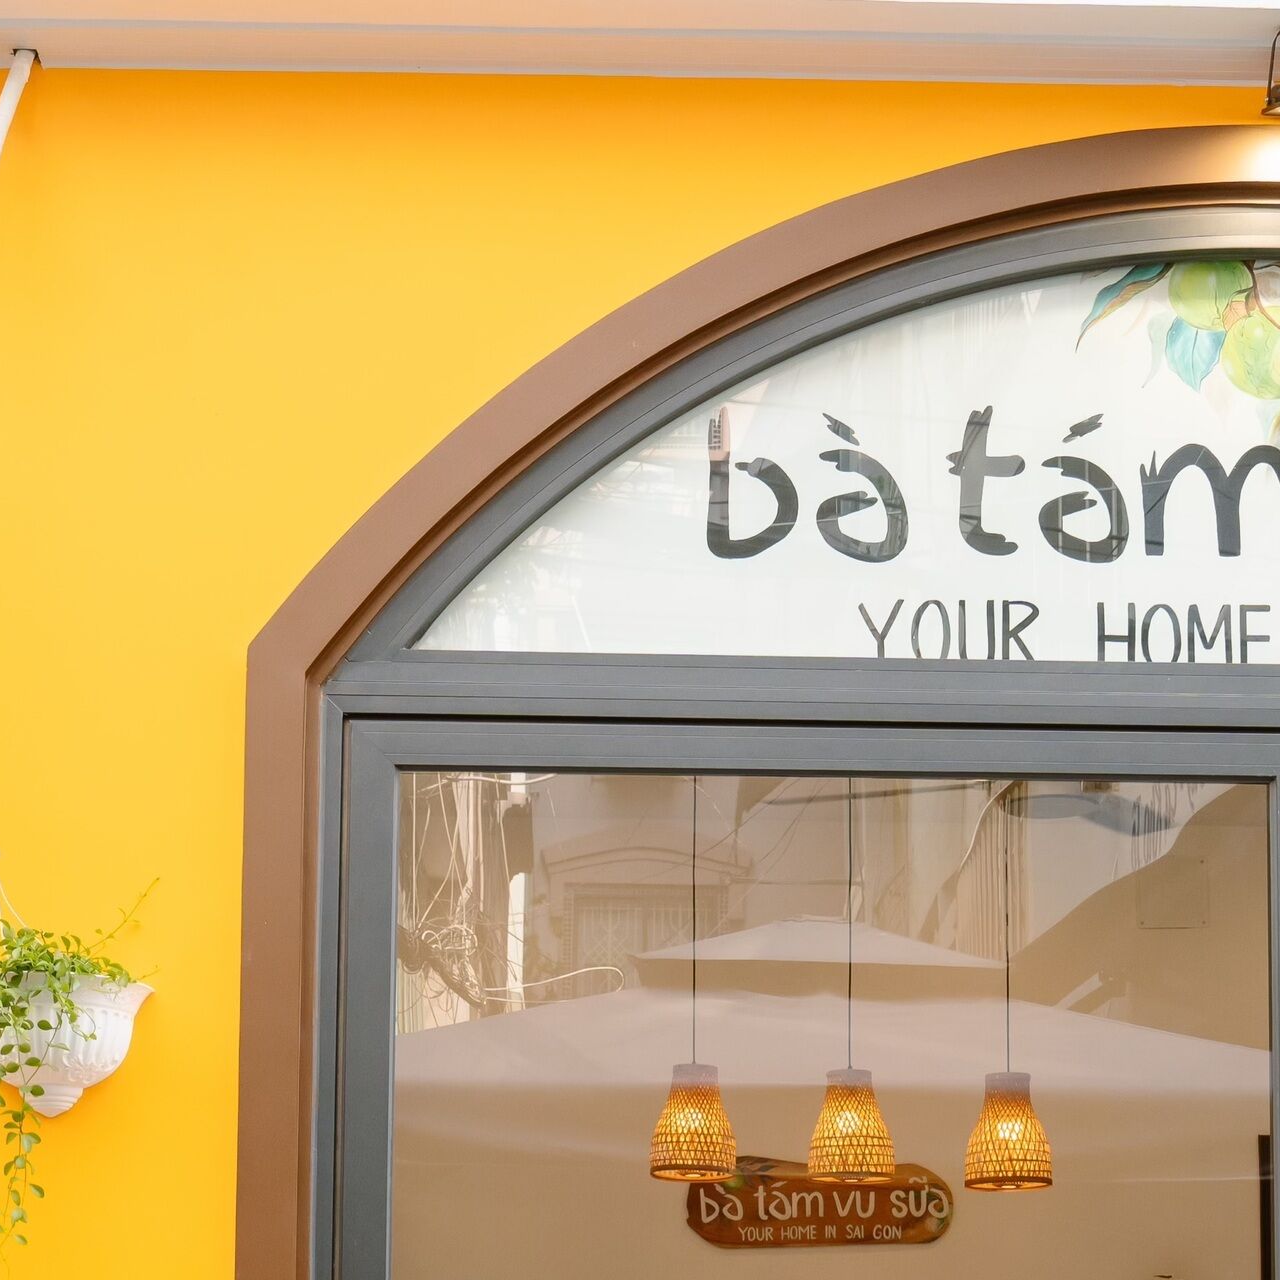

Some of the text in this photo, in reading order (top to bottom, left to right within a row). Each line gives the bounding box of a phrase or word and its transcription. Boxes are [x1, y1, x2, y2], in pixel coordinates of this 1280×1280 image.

[706, 405, 909, 563] bà
[858, 600, 1040, 662] YOUR
[1096, 601, 1271, 664] HOME
[700, 1183, 743, 1224] bà
[753, 1181, 824, 1221] tám
[890, 1176, 949, 1219] sữa
[738, 1224, 902, 1241] YOUR HOME IN SAI GON
